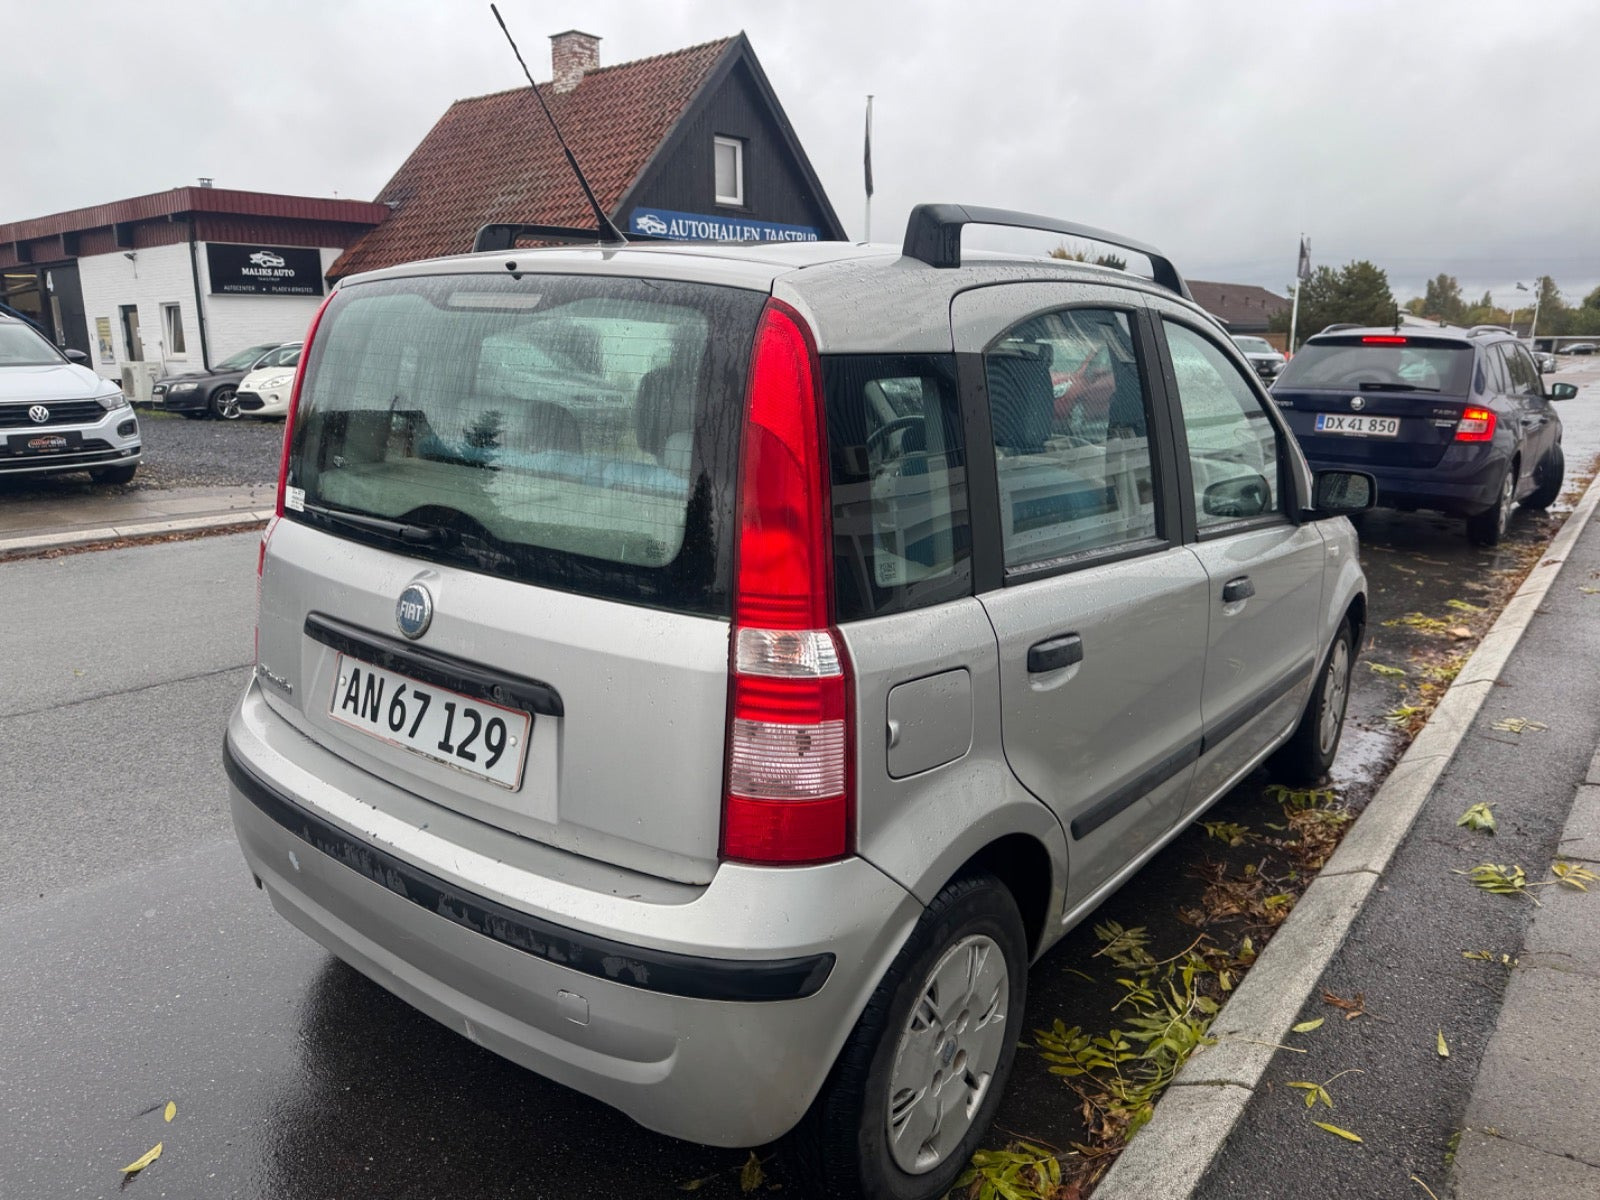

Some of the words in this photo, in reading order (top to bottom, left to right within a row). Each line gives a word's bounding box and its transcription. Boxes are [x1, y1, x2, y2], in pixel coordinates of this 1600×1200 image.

[669, 218, 760, 241] AUTOHALLEN
[46, 271, 54, 292] 4
[242, 267, 272, 276] MALIKS
[273, 269, 295, 277] AUTO
[1325, 416, 1345, 430] DX
[1348, 418, 1363, 431] 41
[1368, 418, 1396, 433] 850
[400, 600, 423, 622] FIAT
[342, 667, 385, 723] AN
[388, 682, 432, 739] 67
[437, 701, 508, 770] 129
